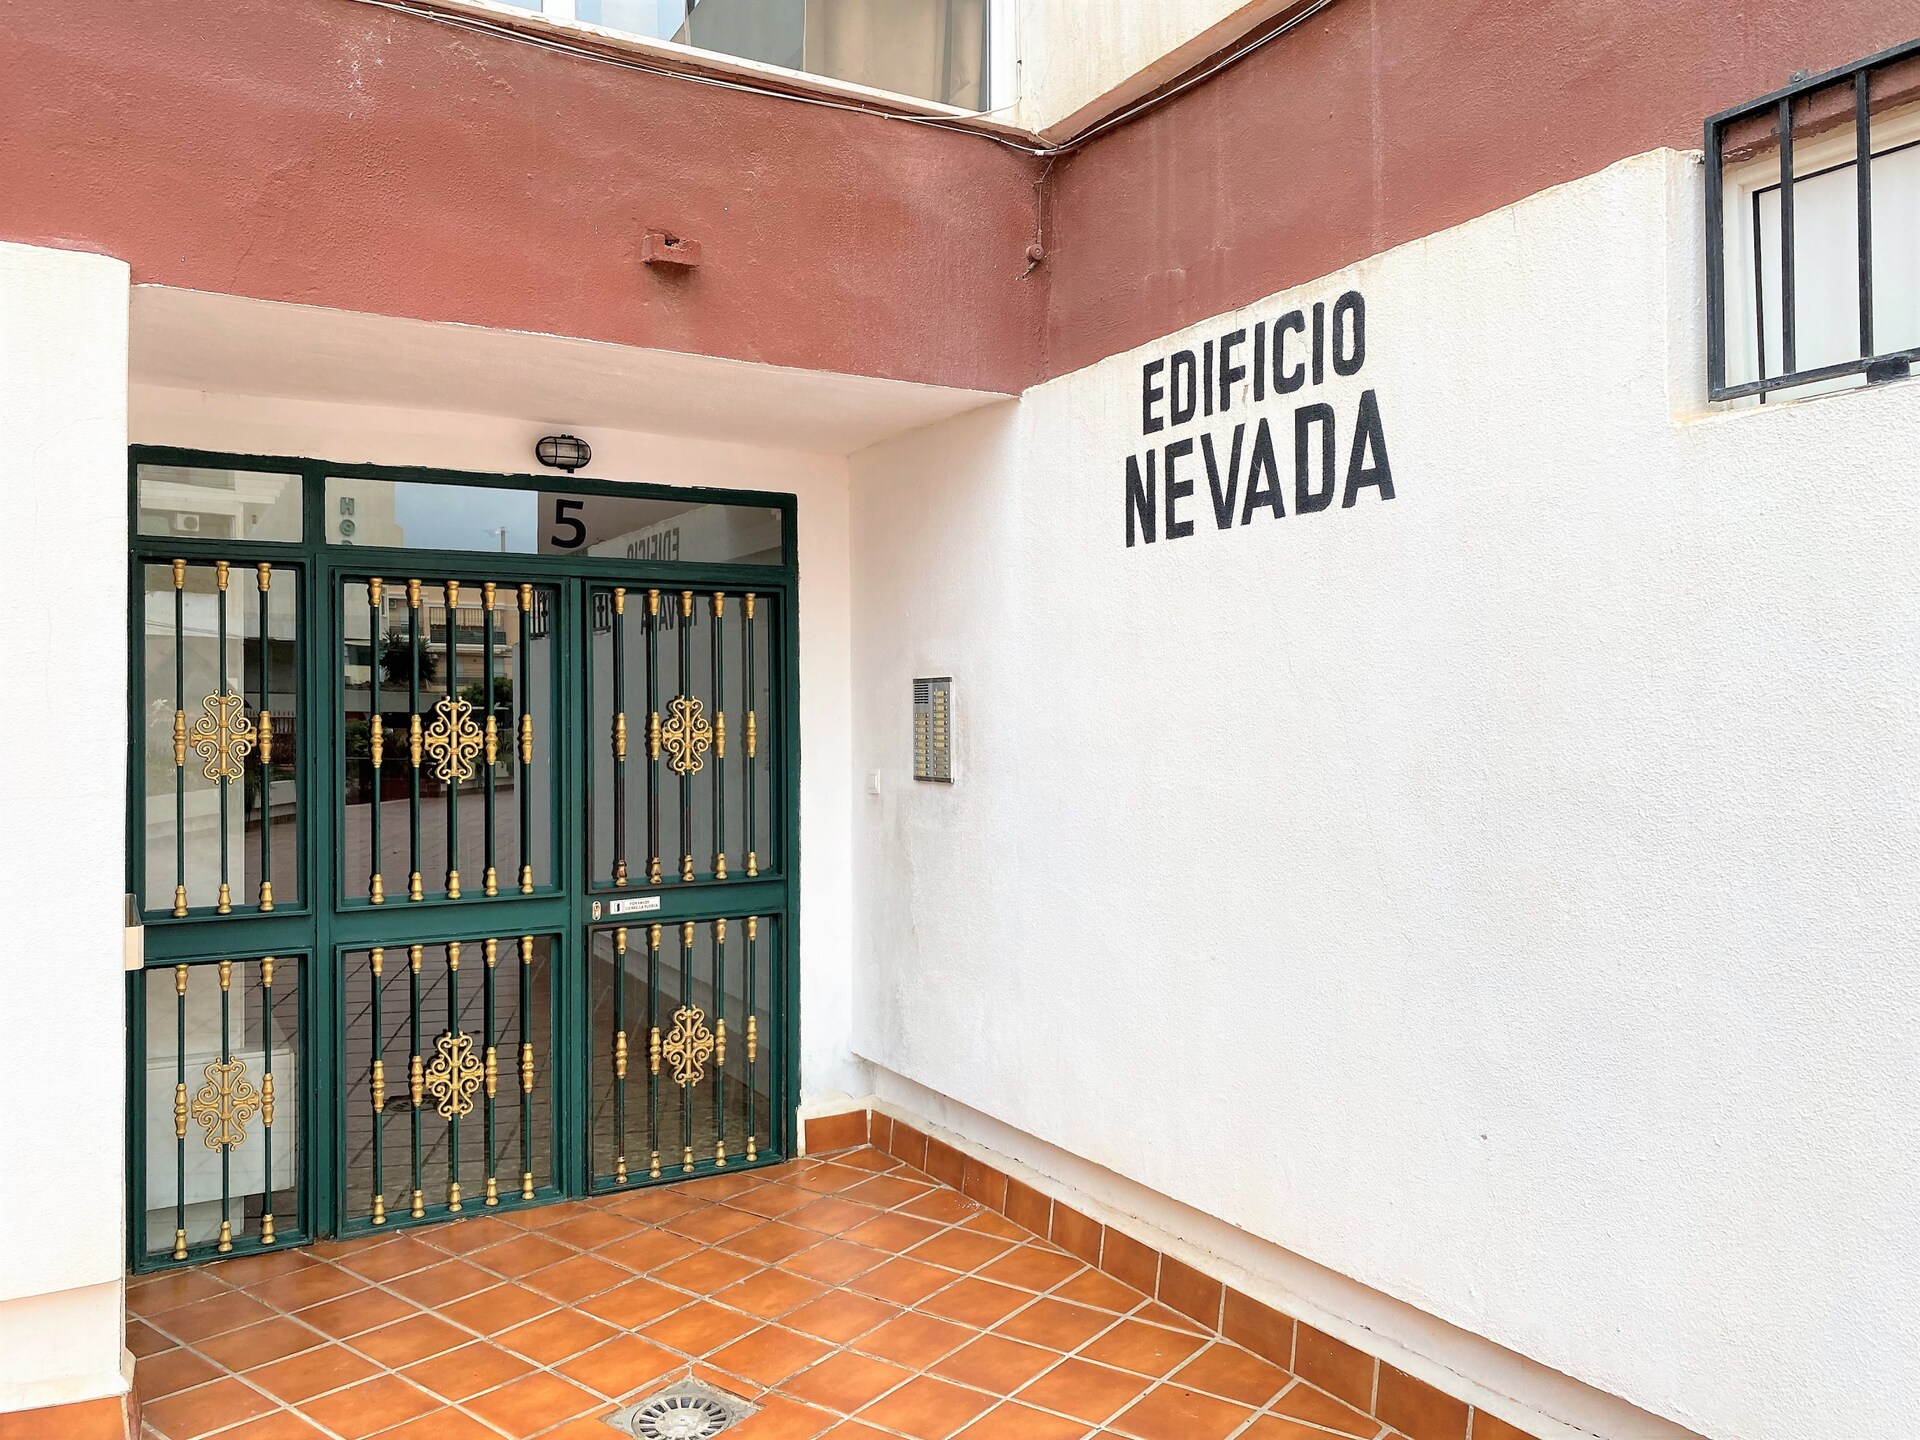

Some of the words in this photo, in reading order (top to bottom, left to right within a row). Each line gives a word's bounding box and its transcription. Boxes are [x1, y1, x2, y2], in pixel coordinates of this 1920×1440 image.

[1143, 290, 1366, 435] EDIFICIO
[551, 499, 587, 549] 5
[1125, 389, 1396, 548] NEVADA
